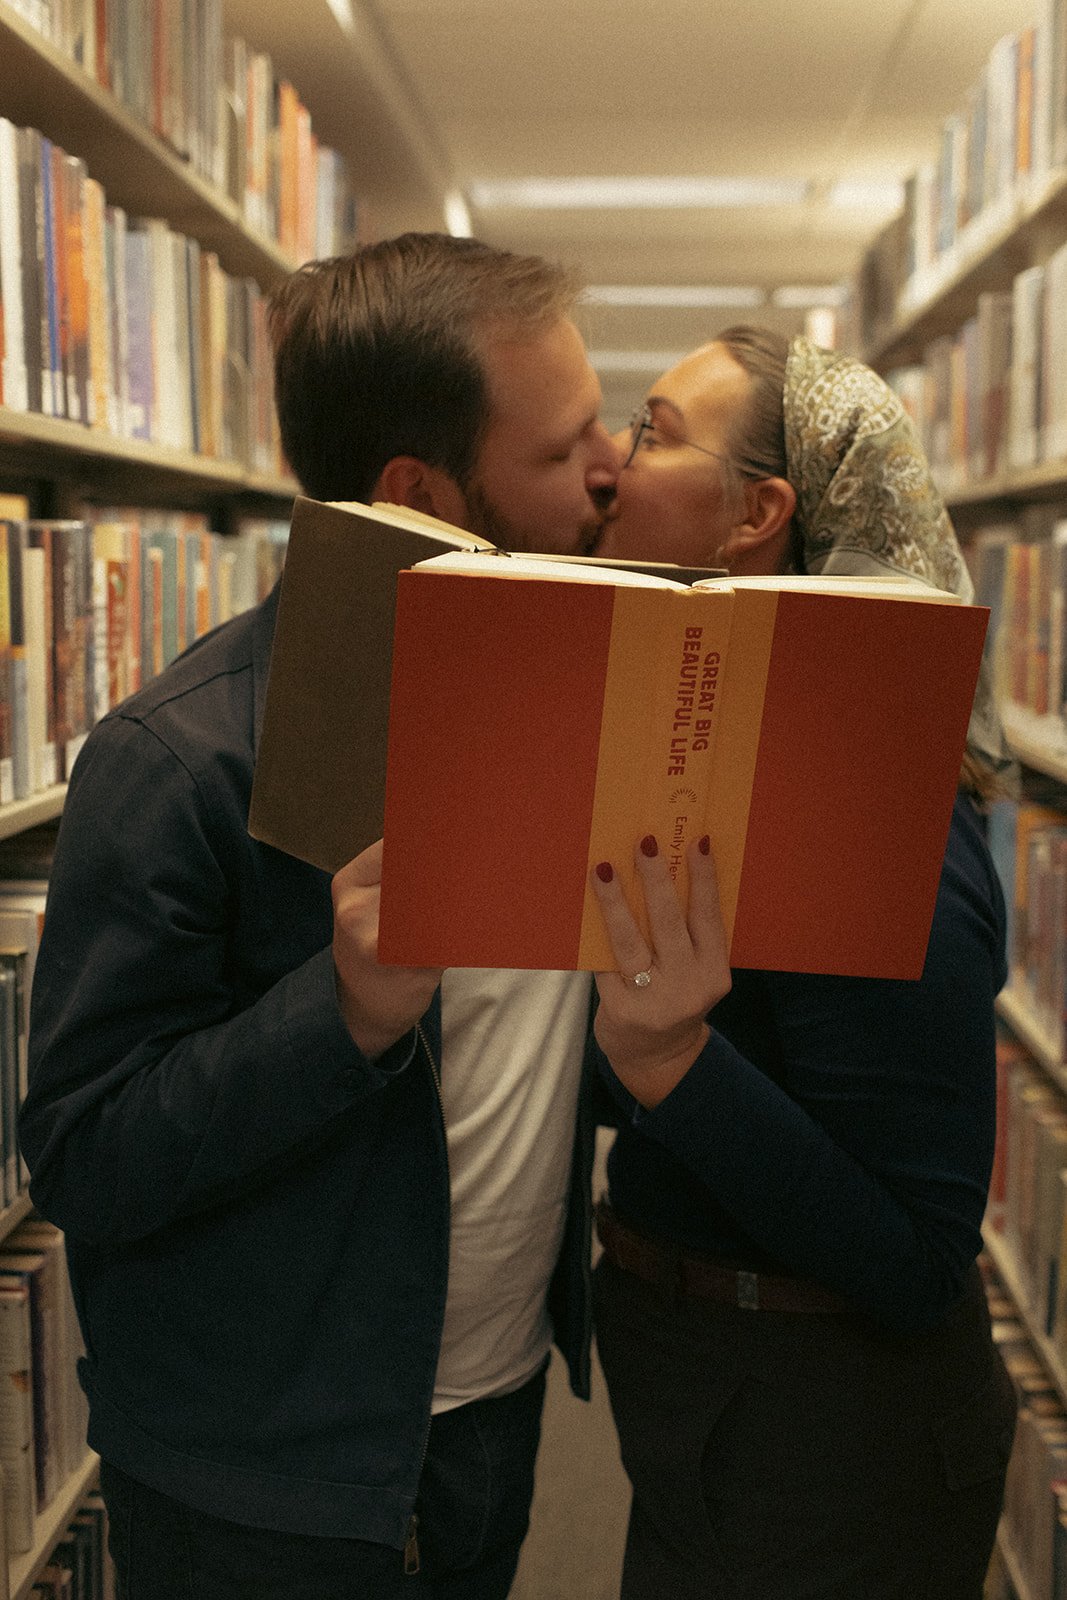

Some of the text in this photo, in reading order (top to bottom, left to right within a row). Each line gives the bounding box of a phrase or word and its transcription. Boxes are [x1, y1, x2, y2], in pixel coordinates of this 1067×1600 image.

[667, 627, 703, 776] BEAUTIFUL LIFE
[692, 652, 721, 751] GREAT BIG
[669, 816, 687, 882] Emily Hen
